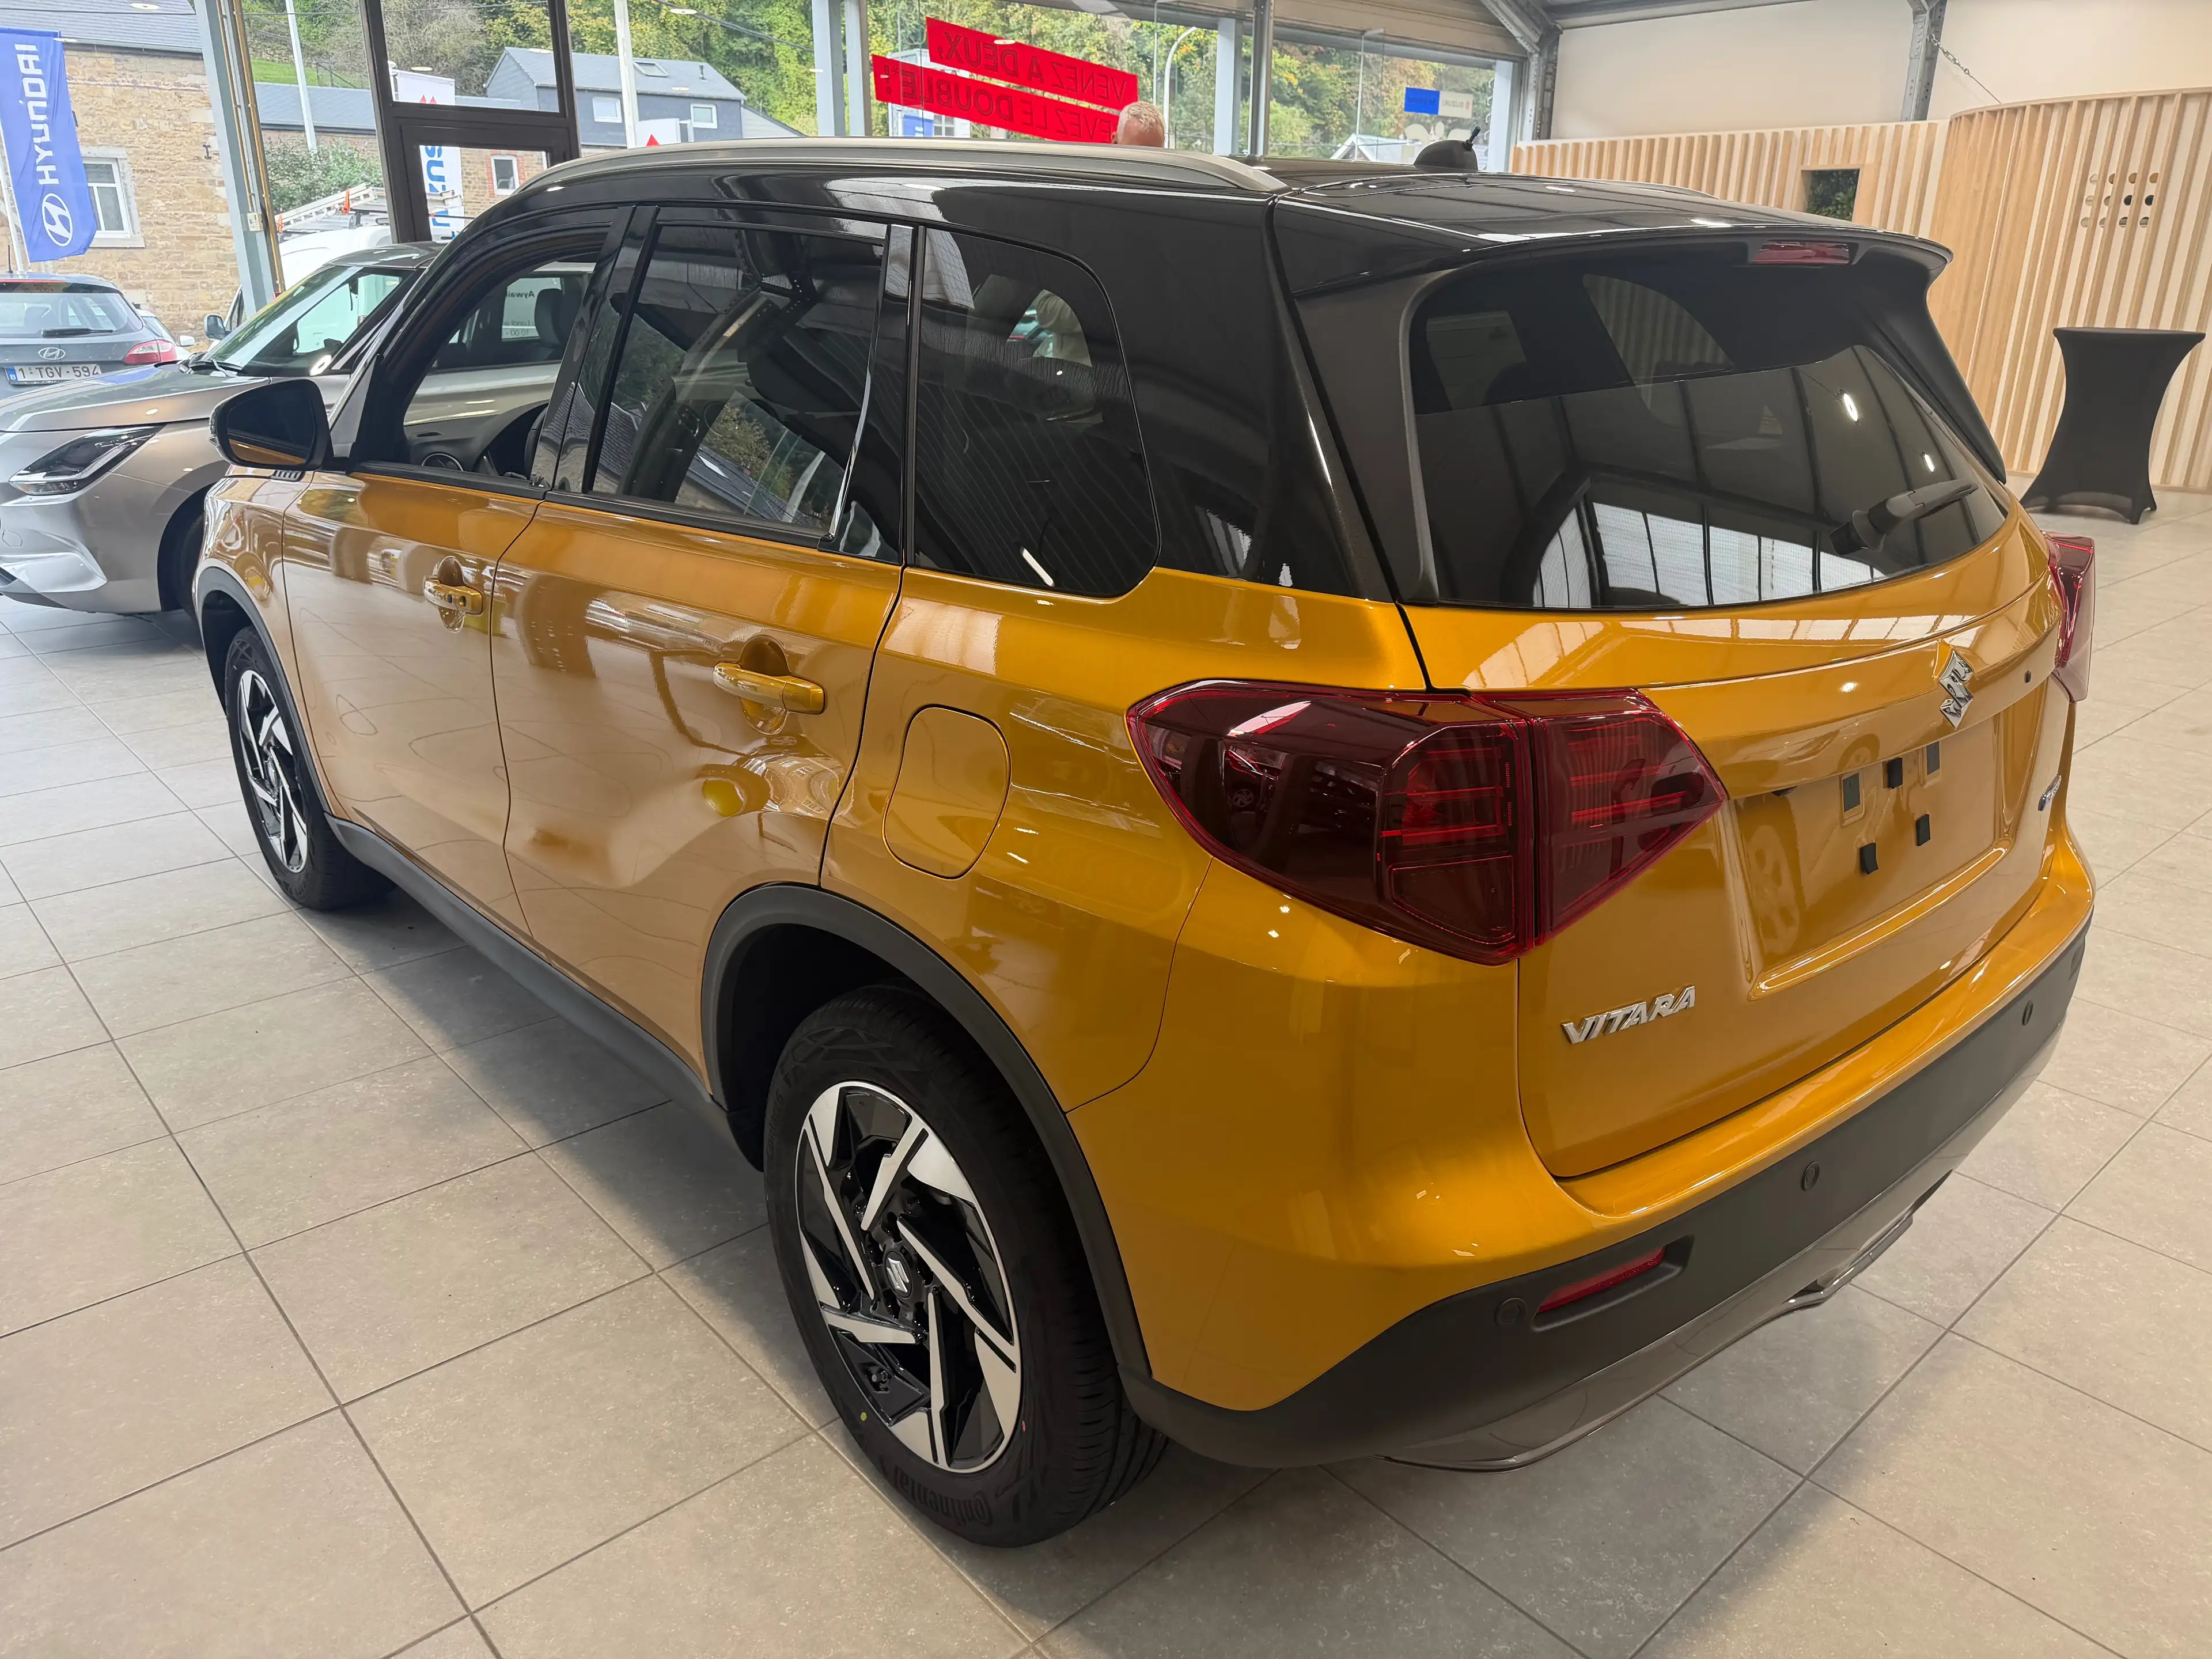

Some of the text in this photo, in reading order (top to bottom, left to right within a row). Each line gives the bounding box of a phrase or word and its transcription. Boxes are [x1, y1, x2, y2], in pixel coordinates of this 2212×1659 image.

[14, 44, 60, 185] HYUNDAI
[1560, 984, 1696, 1044] VITARA
[893, 1464, 994, 1527] Continental
